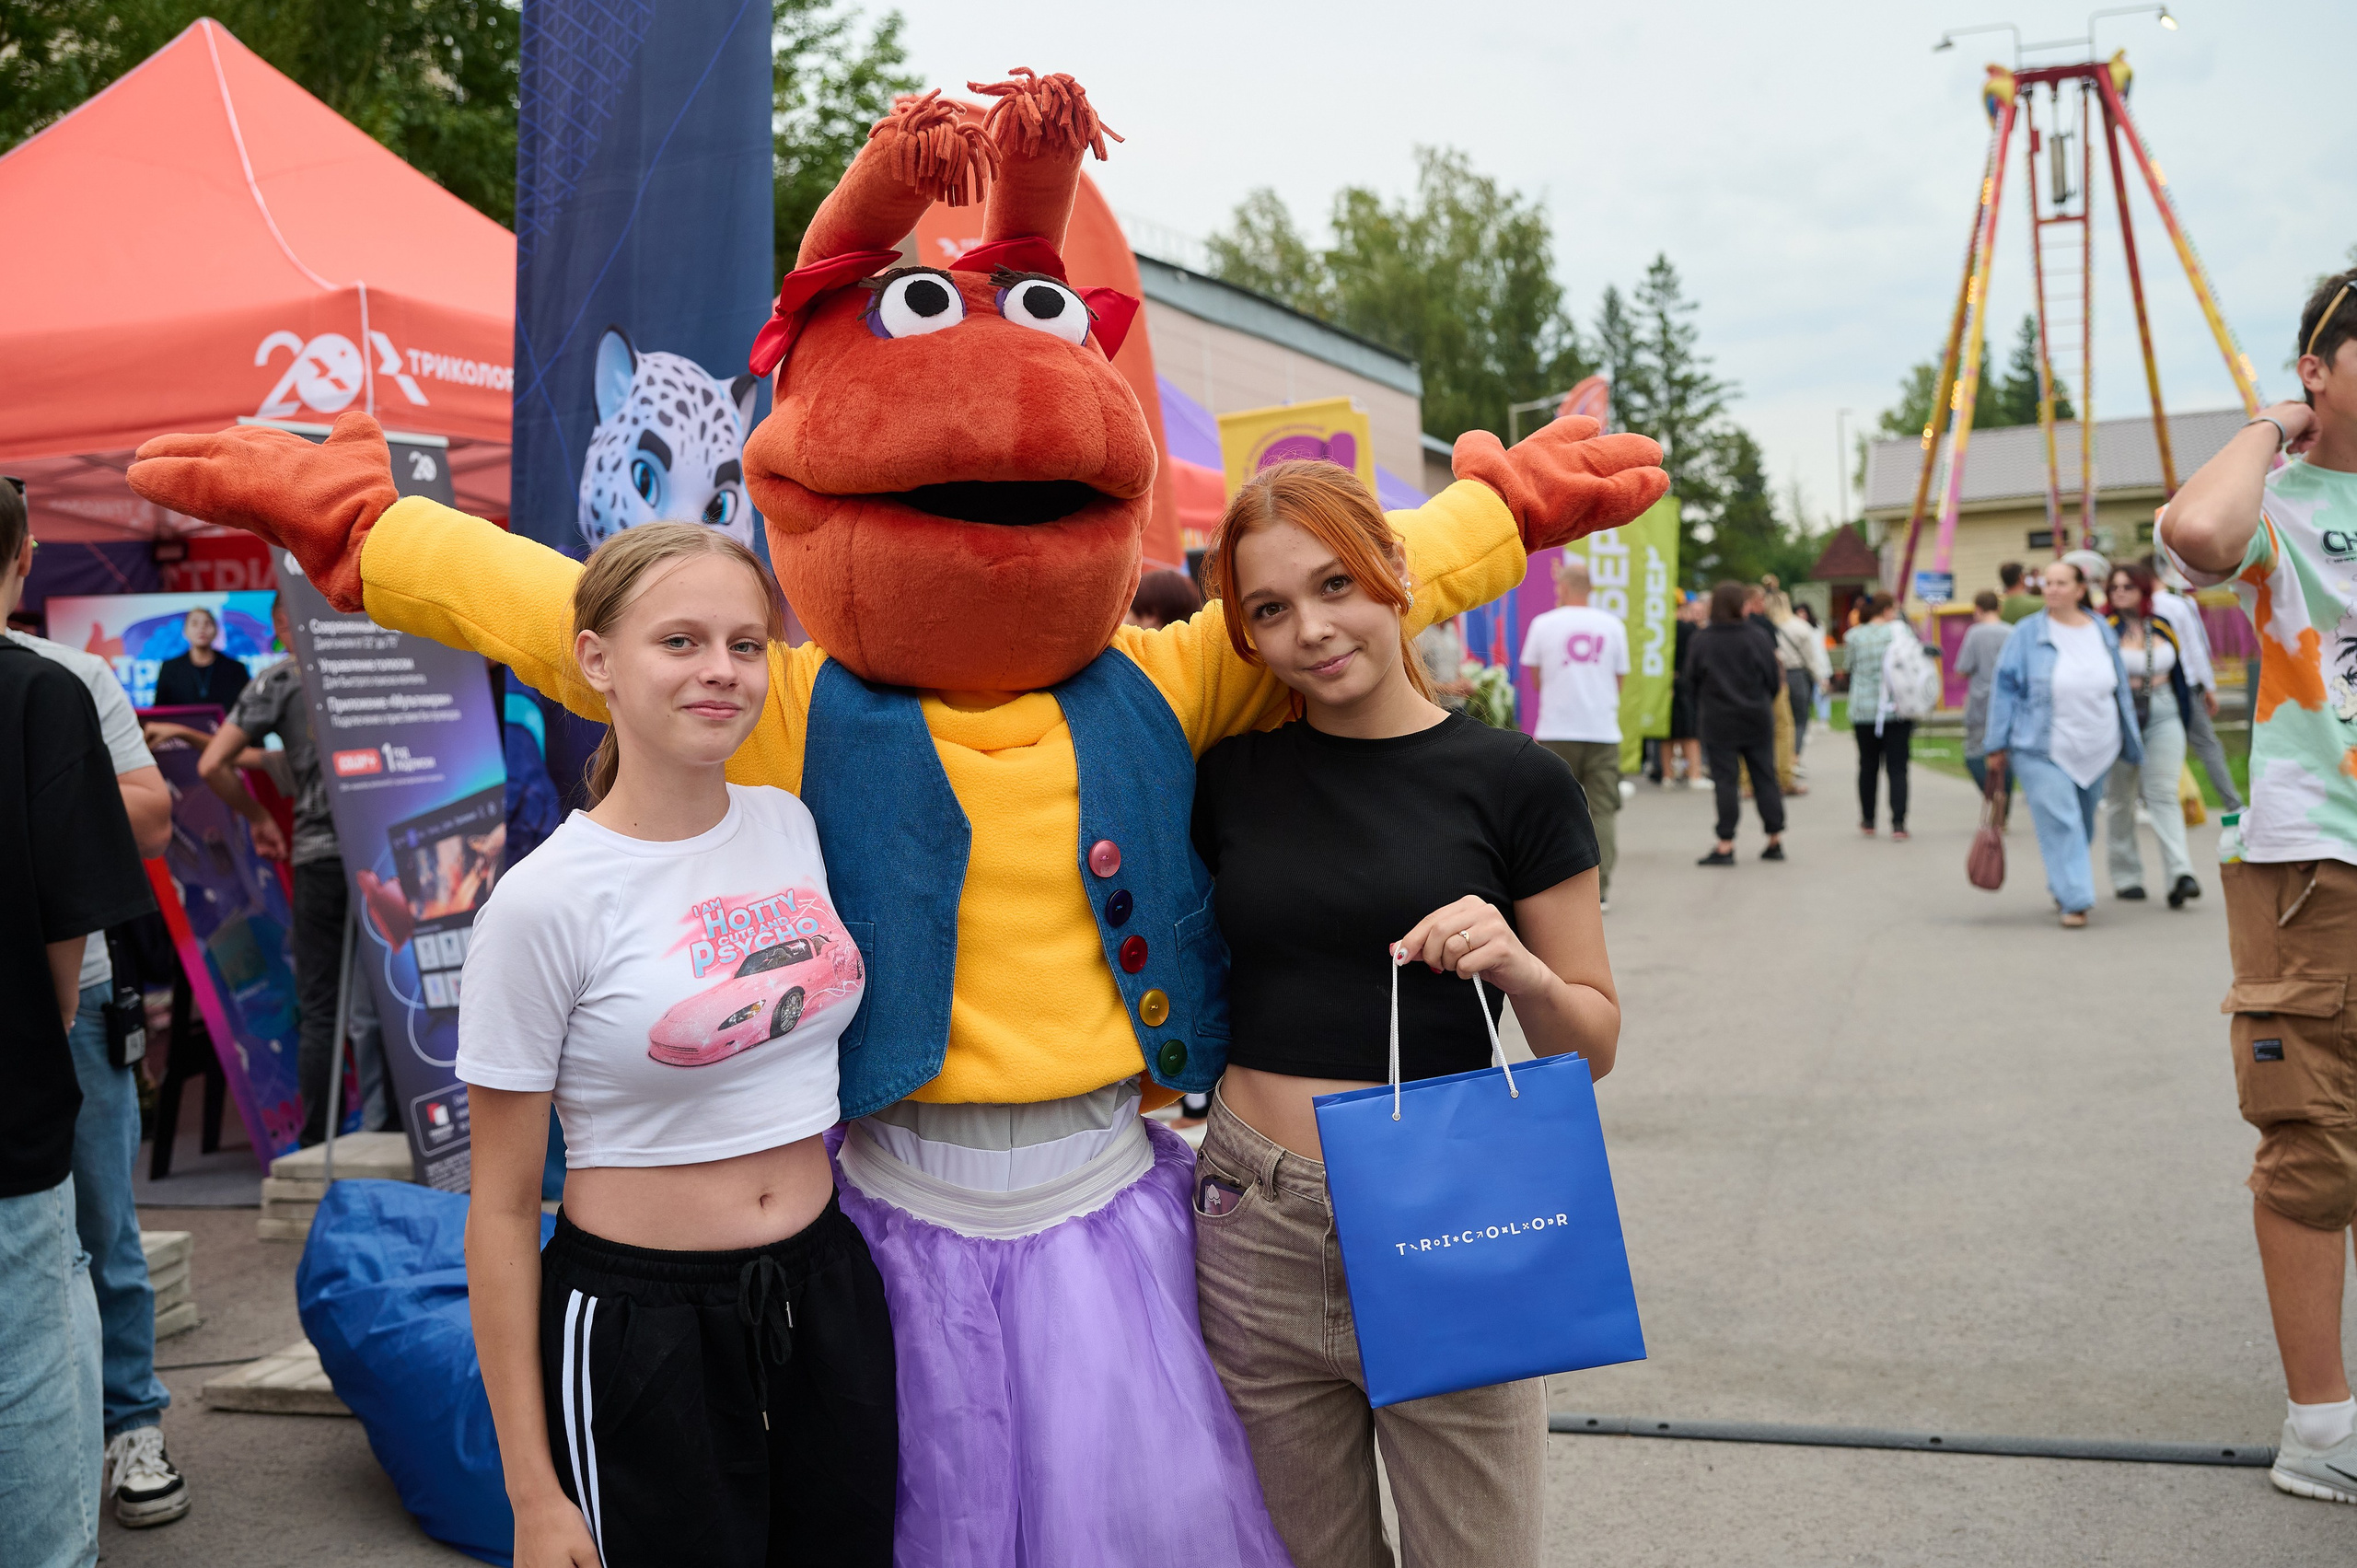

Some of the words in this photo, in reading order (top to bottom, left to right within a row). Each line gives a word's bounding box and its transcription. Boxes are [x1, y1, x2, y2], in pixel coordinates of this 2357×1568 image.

[693, 906, 699, 917] I
[702, 898, 722, 914] AM
[702, 889, 797, 939] HOTTY
[691, 917, 819, 978] PSYCHO
[718, 926, 755, 947] CUTE
[759, 916, 790, 934] AND
